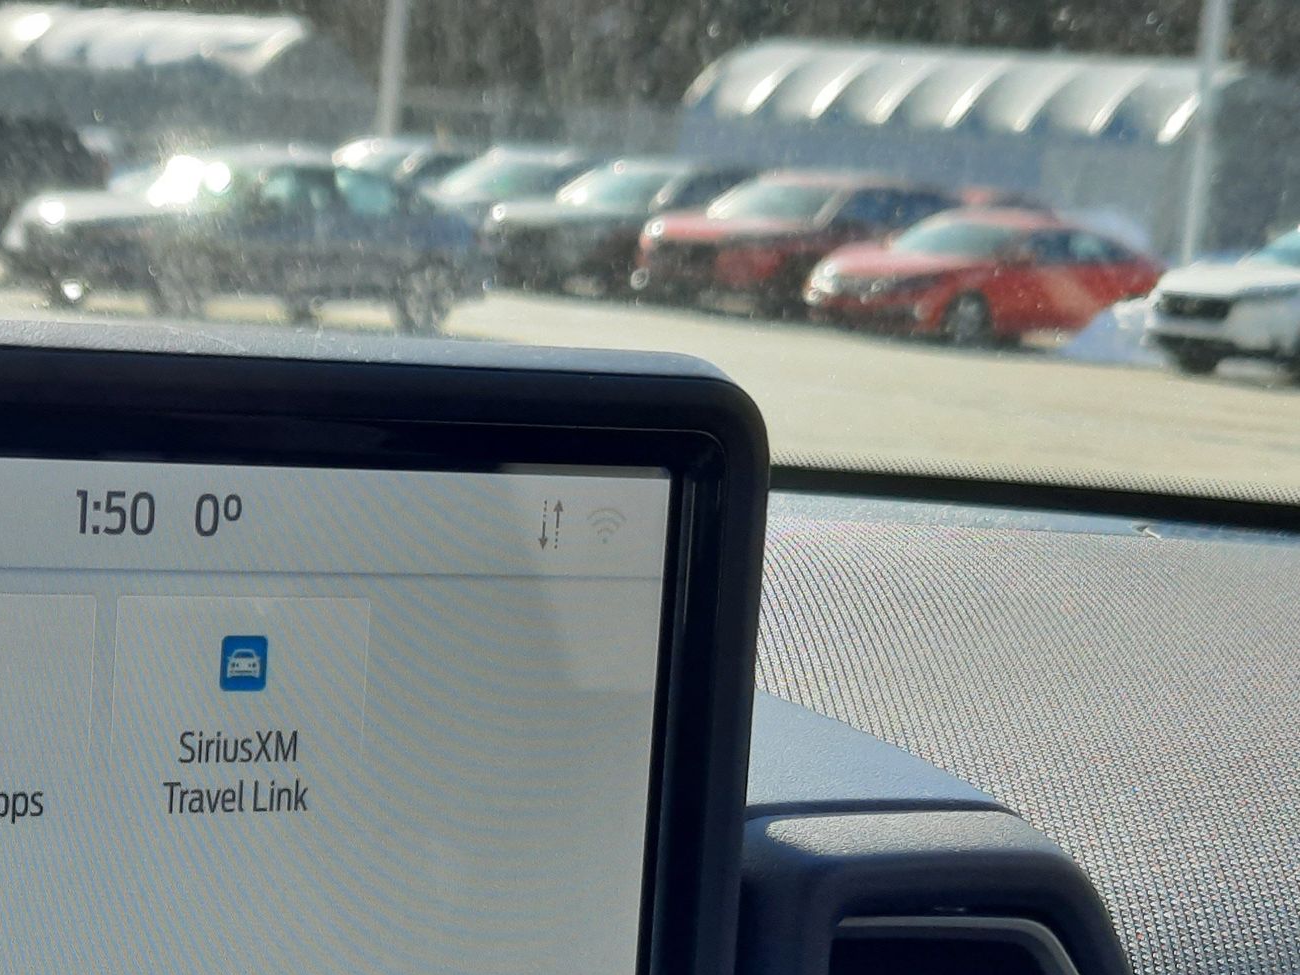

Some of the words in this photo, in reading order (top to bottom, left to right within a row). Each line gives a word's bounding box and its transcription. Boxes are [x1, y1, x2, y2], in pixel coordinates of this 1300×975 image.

[76, 489, 156, 536] 1:50
[178, 730, 299, 764] SiriusXM
[163, 781, 243, 815] Travel
[252, 778, 309, 813] Link
